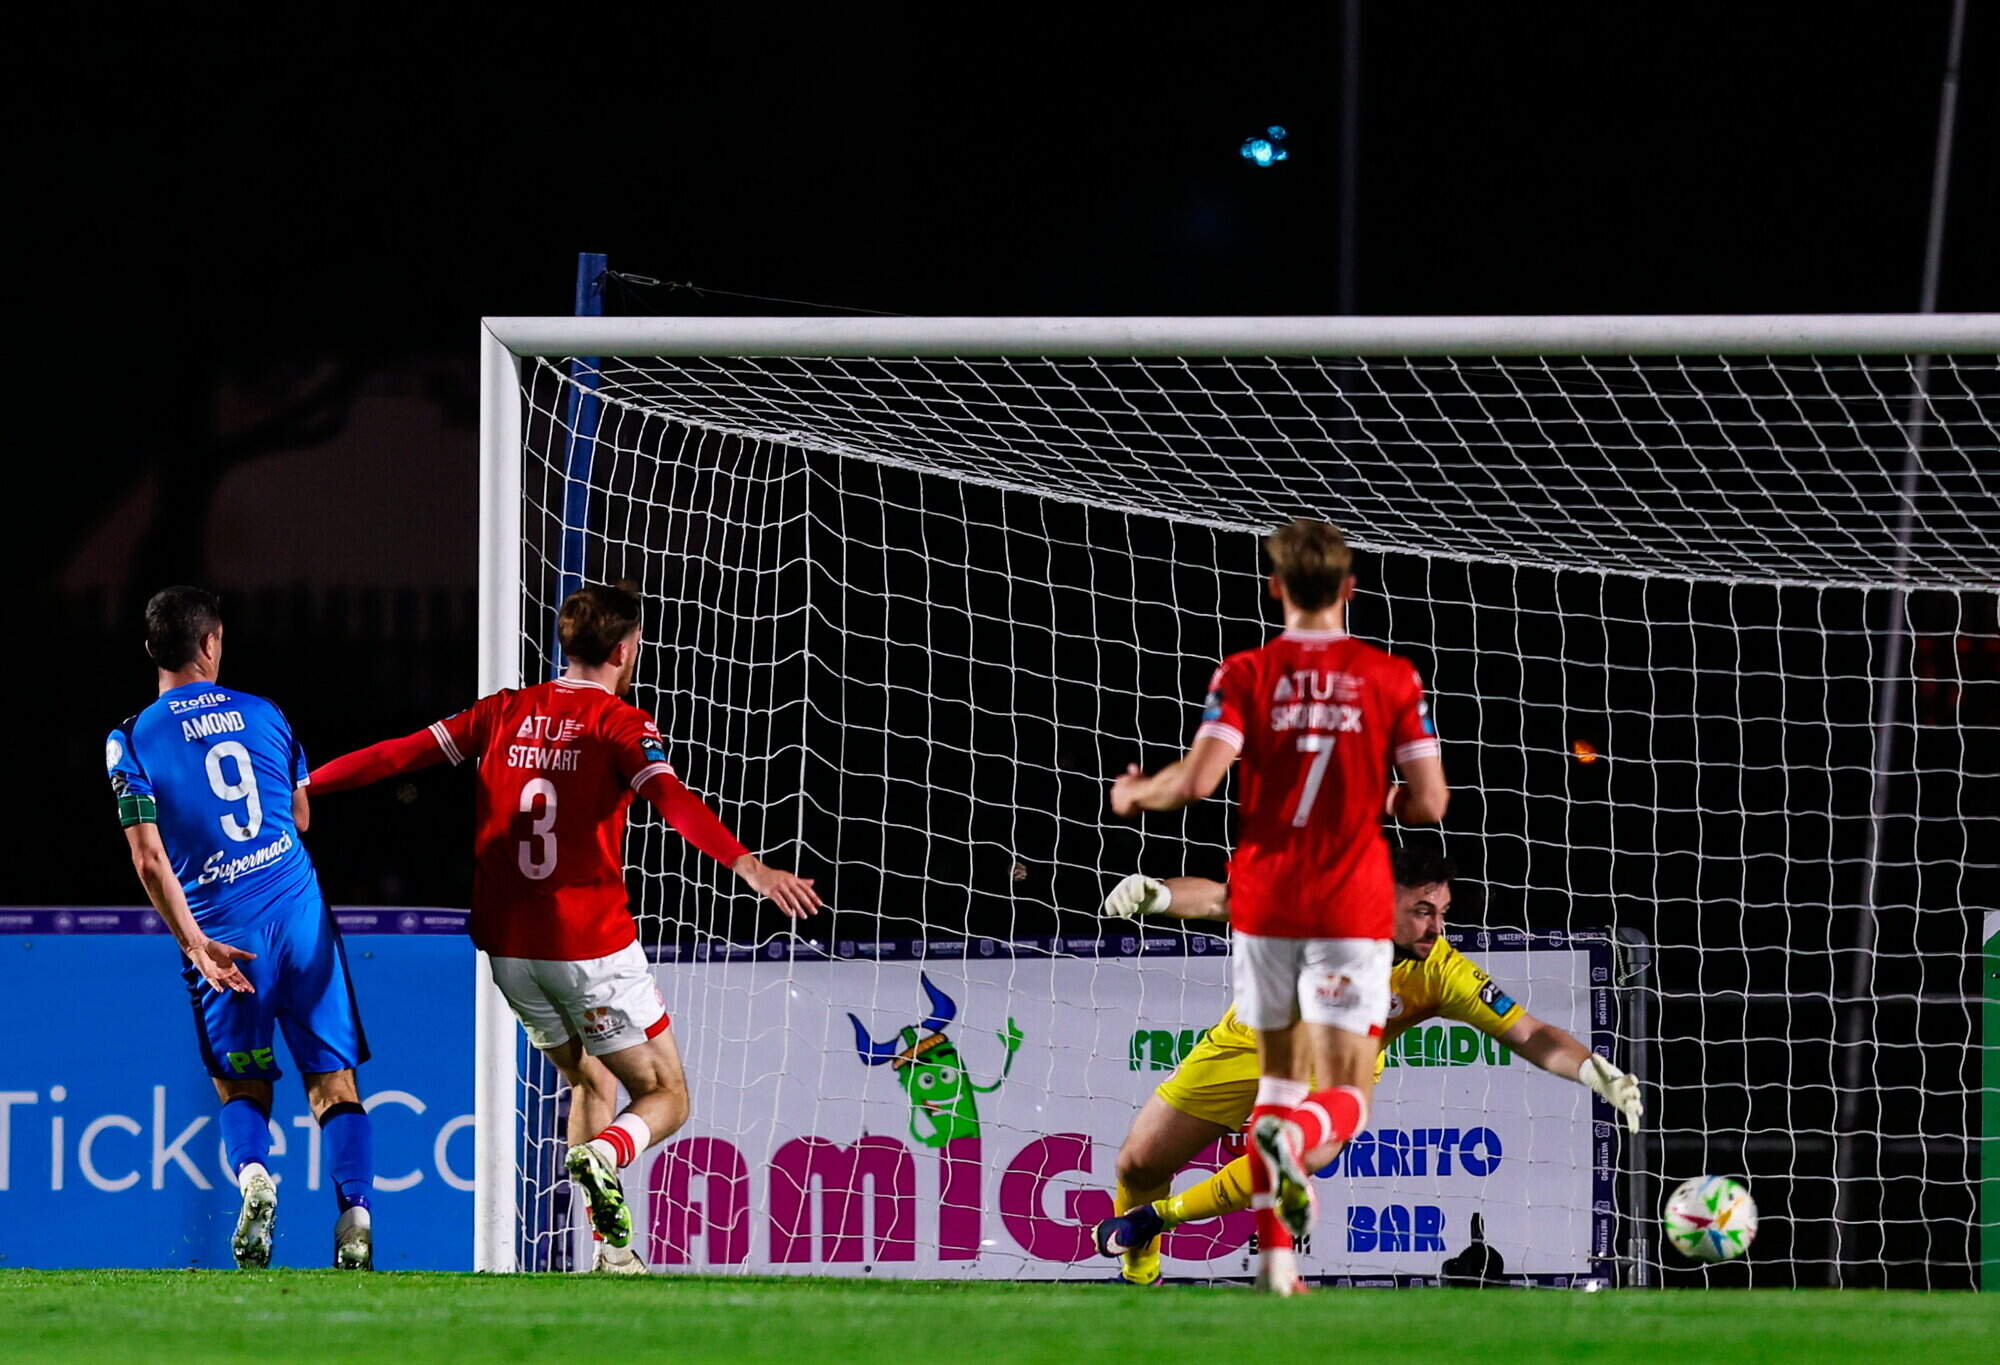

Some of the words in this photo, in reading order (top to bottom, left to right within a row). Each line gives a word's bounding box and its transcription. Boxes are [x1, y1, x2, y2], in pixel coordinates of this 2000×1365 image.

[181, 711, 245, 742] AMOND
[516, 716, 563, 741] ATU
[508, 745, 581, 771] STEWART
[1292, 735, 1336, 827] 7
[205, 740, 263, 842] 9
[518, 777, 558, 880] 3
[1346, 1204, 1447, 1253] BAR
